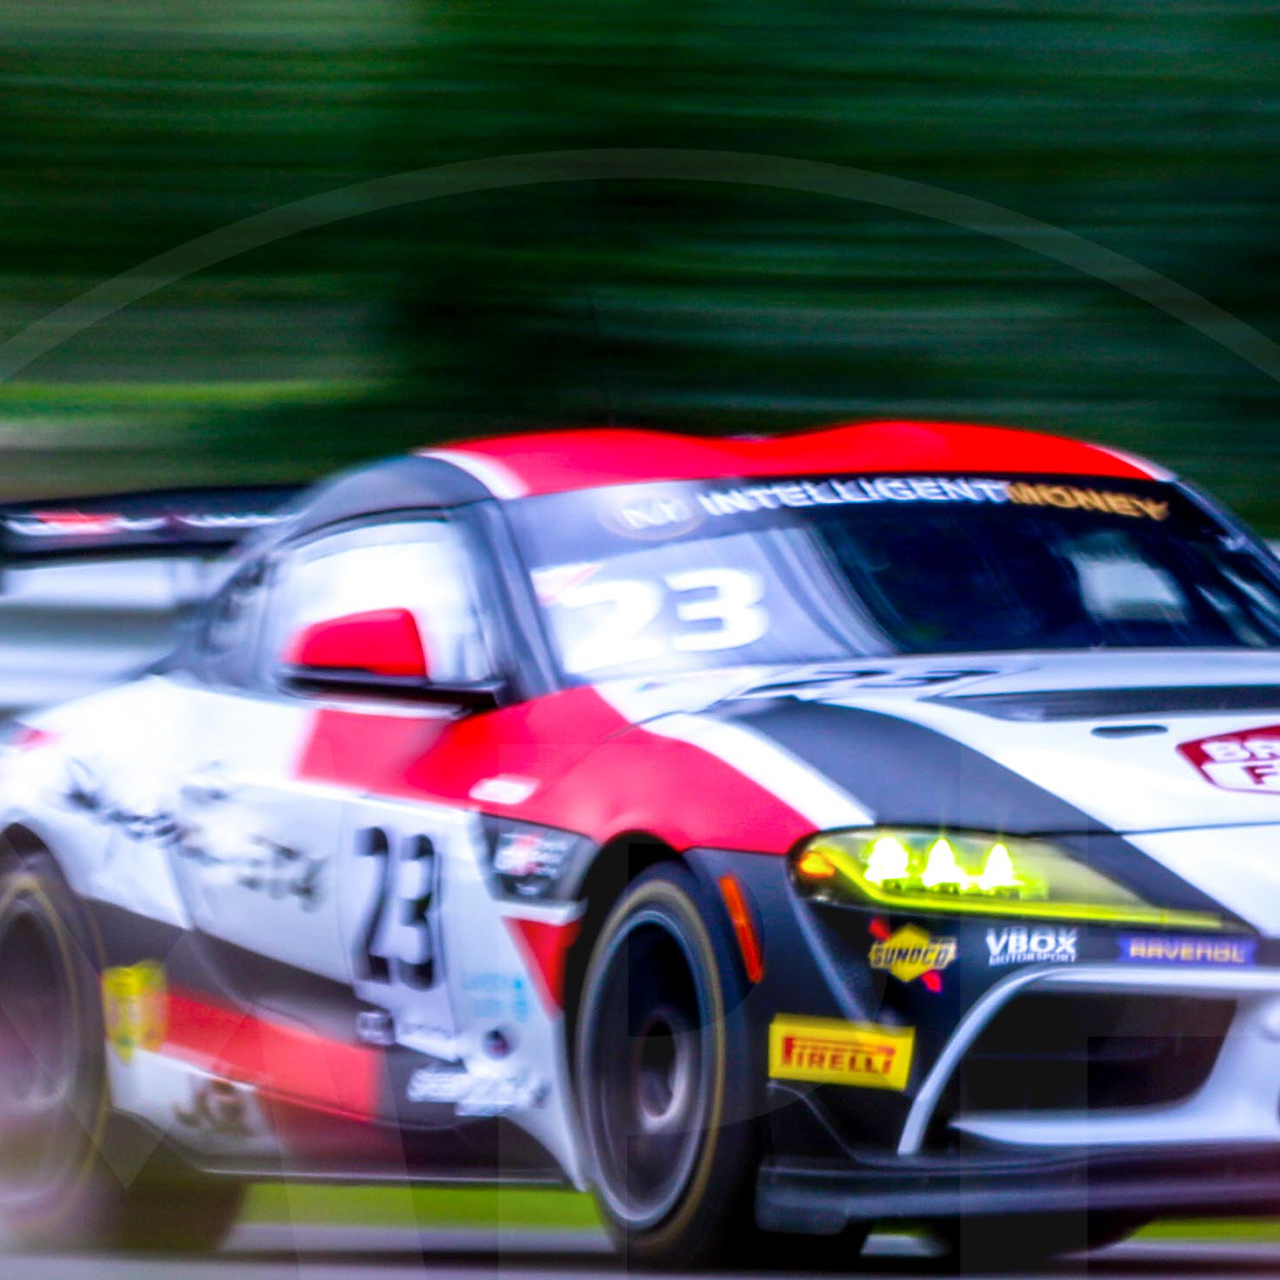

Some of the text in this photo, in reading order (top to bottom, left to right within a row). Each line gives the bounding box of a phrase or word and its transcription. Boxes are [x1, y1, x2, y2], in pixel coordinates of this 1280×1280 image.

[558, 567, 770, 673] 23
[354, 826, 437, 992] 23
[869, 940, 956, 969] SUNOCO
[986, 926, 1078, 955] VBOX
[781, 1036, 896, 1075] PIRELLI
